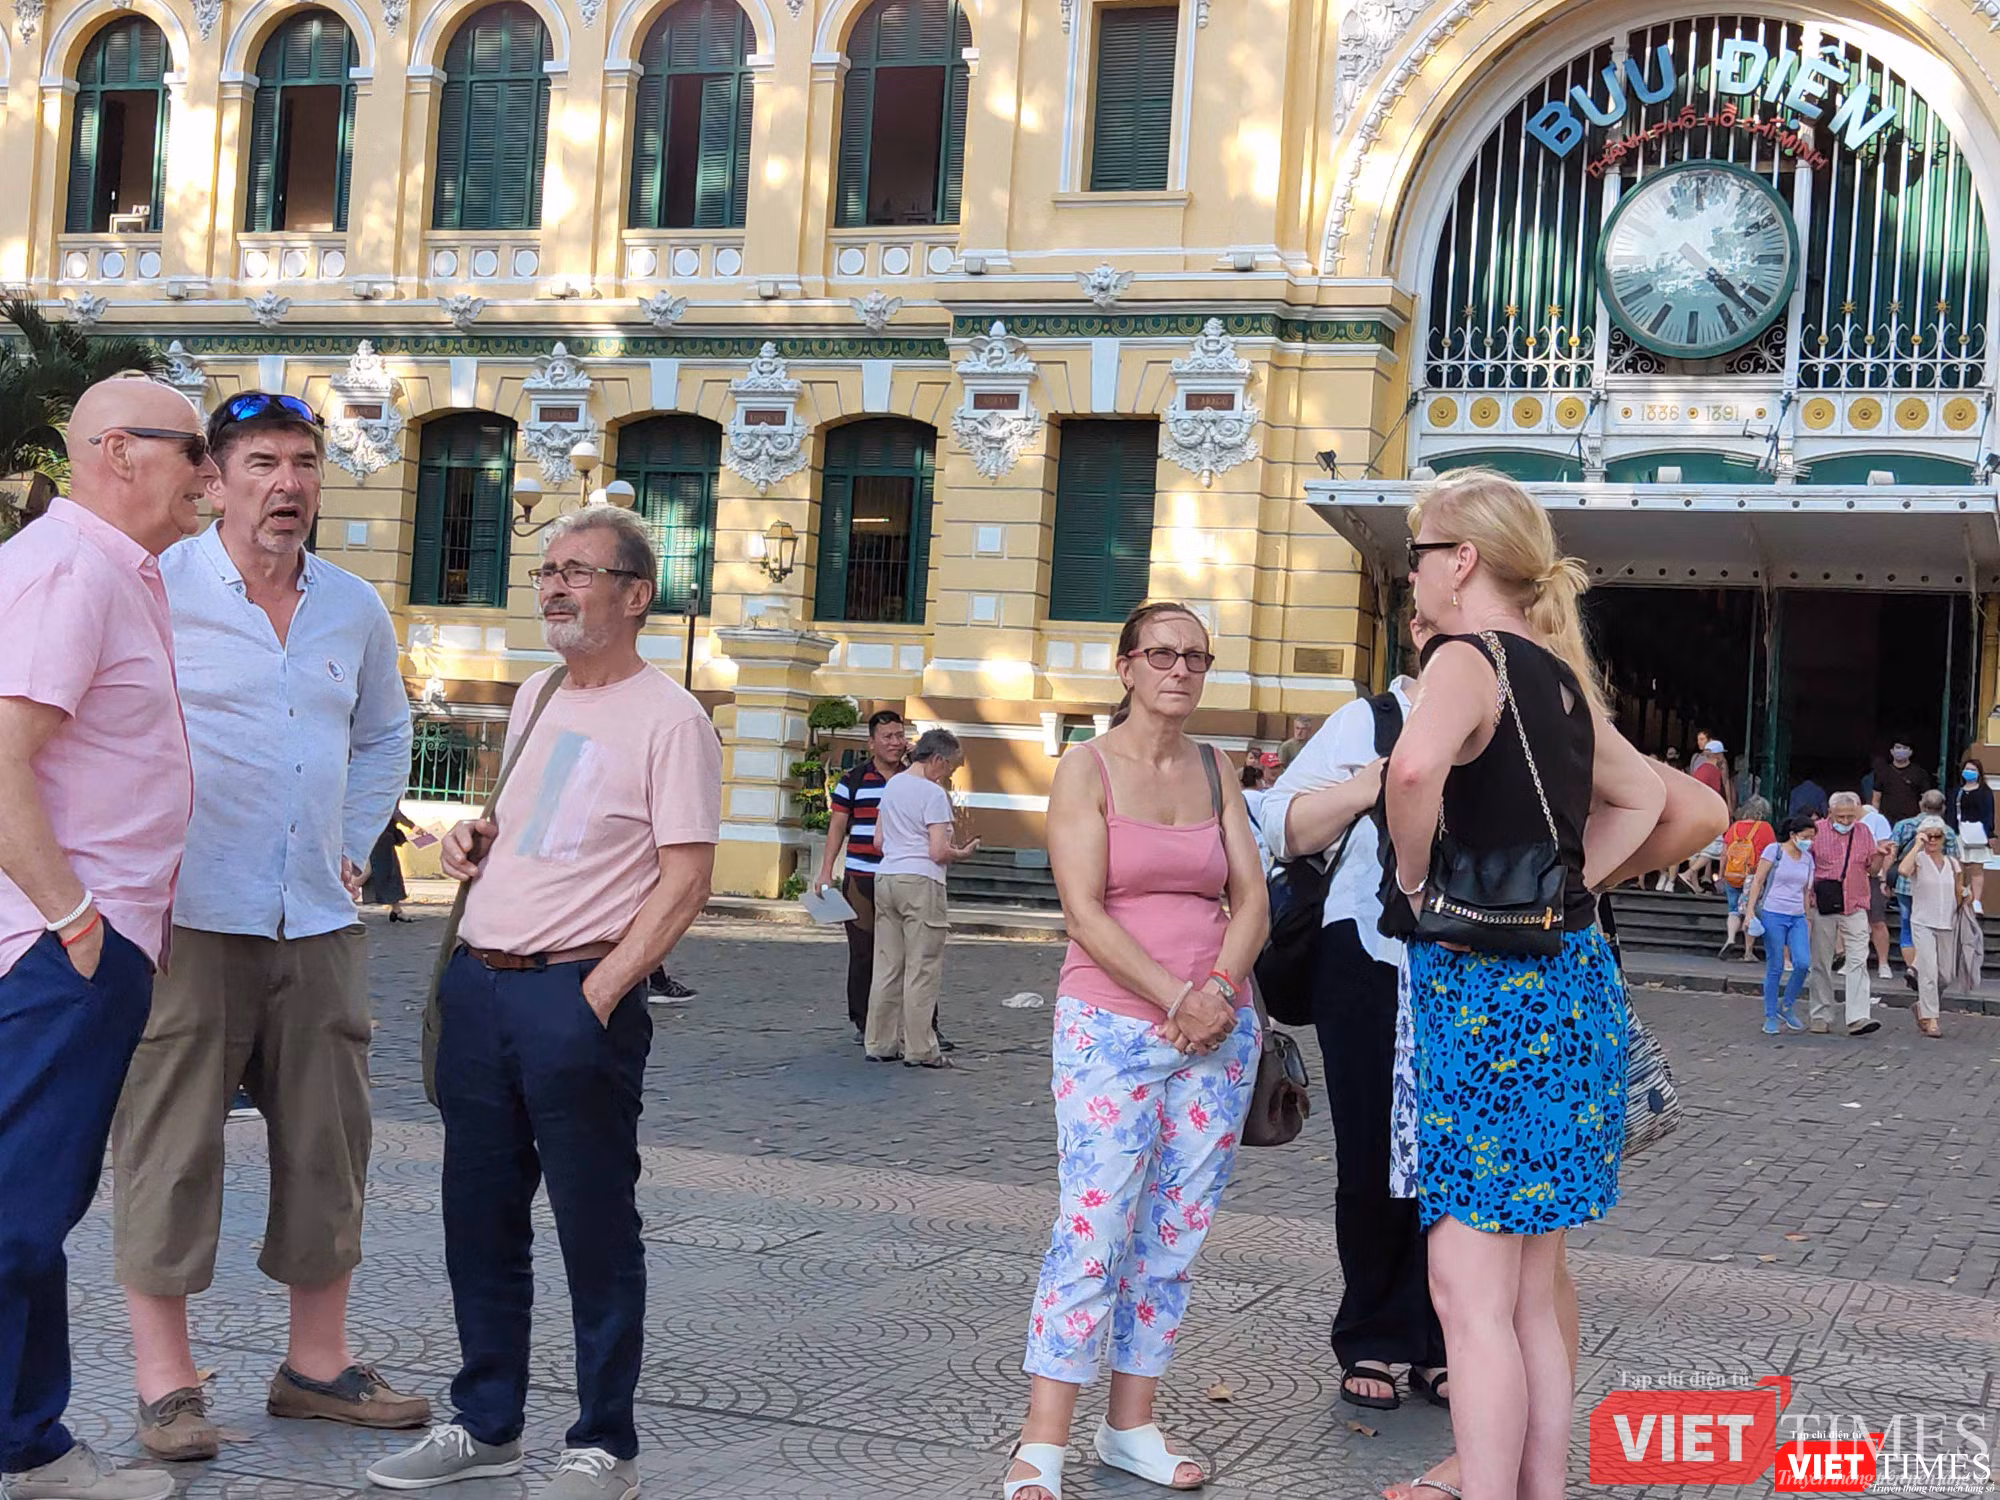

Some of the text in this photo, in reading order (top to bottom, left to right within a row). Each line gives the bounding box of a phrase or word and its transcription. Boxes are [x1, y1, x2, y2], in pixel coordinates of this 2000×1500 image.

[1716, 38, 1897, 151] ĐIỆN
[1587, 130, 1650, 177] THÀNH
[1779, 130, 1829, 169] MINH
